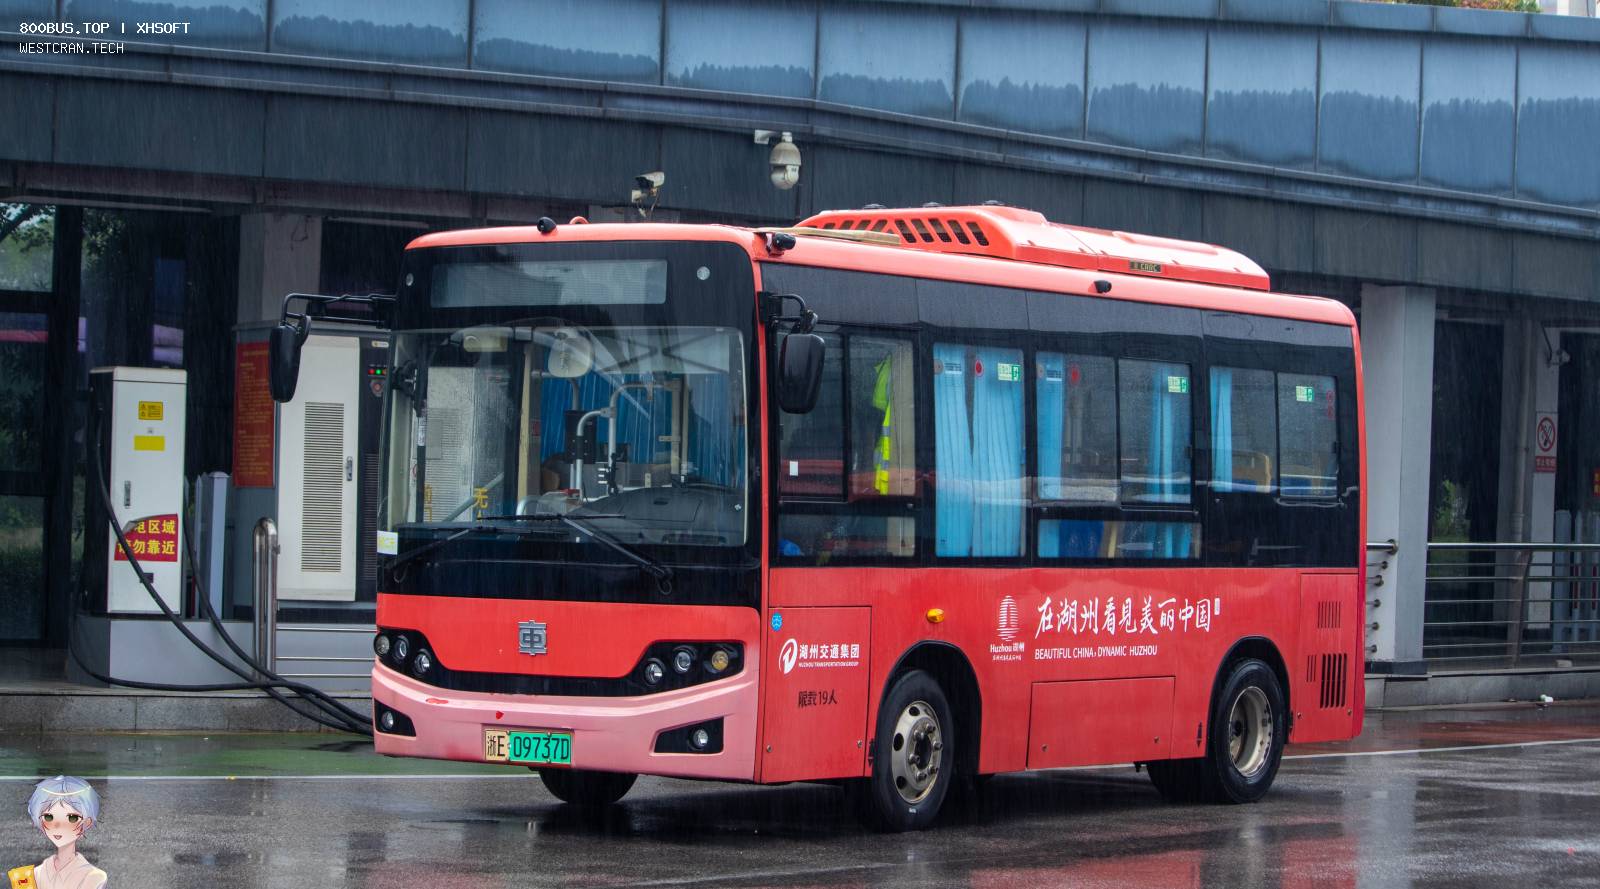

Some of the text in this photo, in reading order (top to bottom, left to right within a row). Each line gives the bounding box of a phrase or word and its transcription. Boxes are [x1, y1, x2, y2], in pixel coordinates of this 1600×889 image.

[135, 520, 175, 534] 电区域
[799, 644, 860, 659] 湖州交通集团
[1034, 648, 1071, 660] BEAUTIFUL
[1097, 645, 1127, 657] DYNAMIC
[1129, 645, 1158, 656] HUZHOU
[513, 736, 570, 760] 09737D
